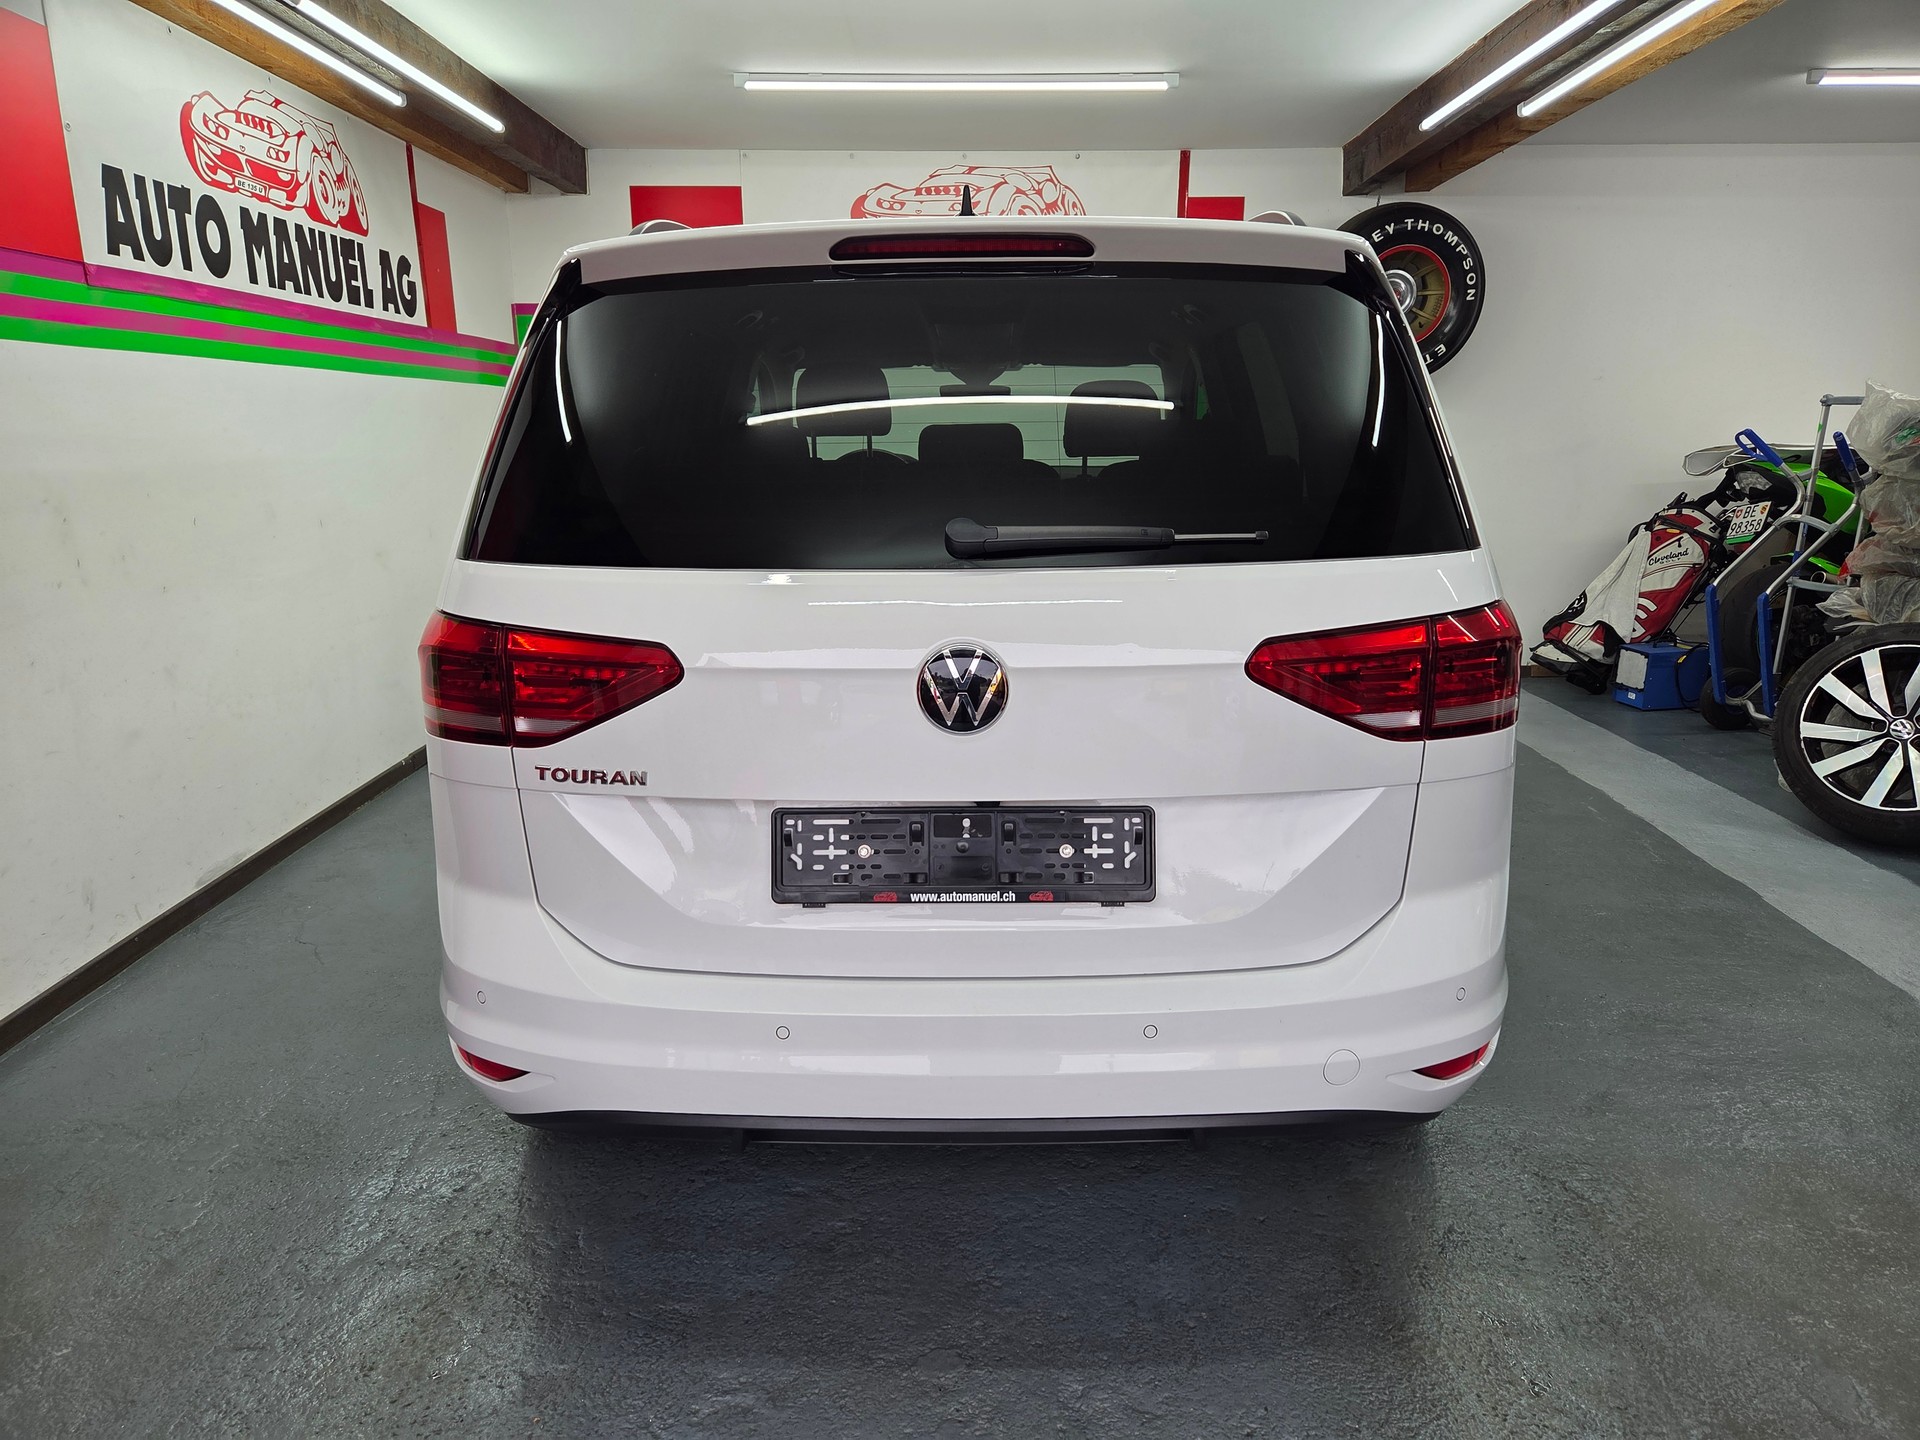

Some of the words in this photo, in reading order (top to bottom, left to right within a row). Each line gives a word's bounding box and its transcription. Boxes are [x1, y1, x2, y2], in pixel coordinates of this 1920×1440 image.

[237, 180, 246, 188] BE
[247, 183, 258, 192] 135
[101, 163, 231, 279] AUTO
[239, 205, 375, 310] MANUEL
[379, 249, 417, 319] AG
[1404, 218, 1477, 301] THOMPSON
[1743, 504, 1760, 519] BE
[1730, 518, 1763, 535] 98358
[1648, 547, 1690, 566] Cleveland
[922, 647, 1004, 730] VW
[534, 765, 648, 786] TOURAN
[910, 890, 1016, 902] www.automanuel.ch
